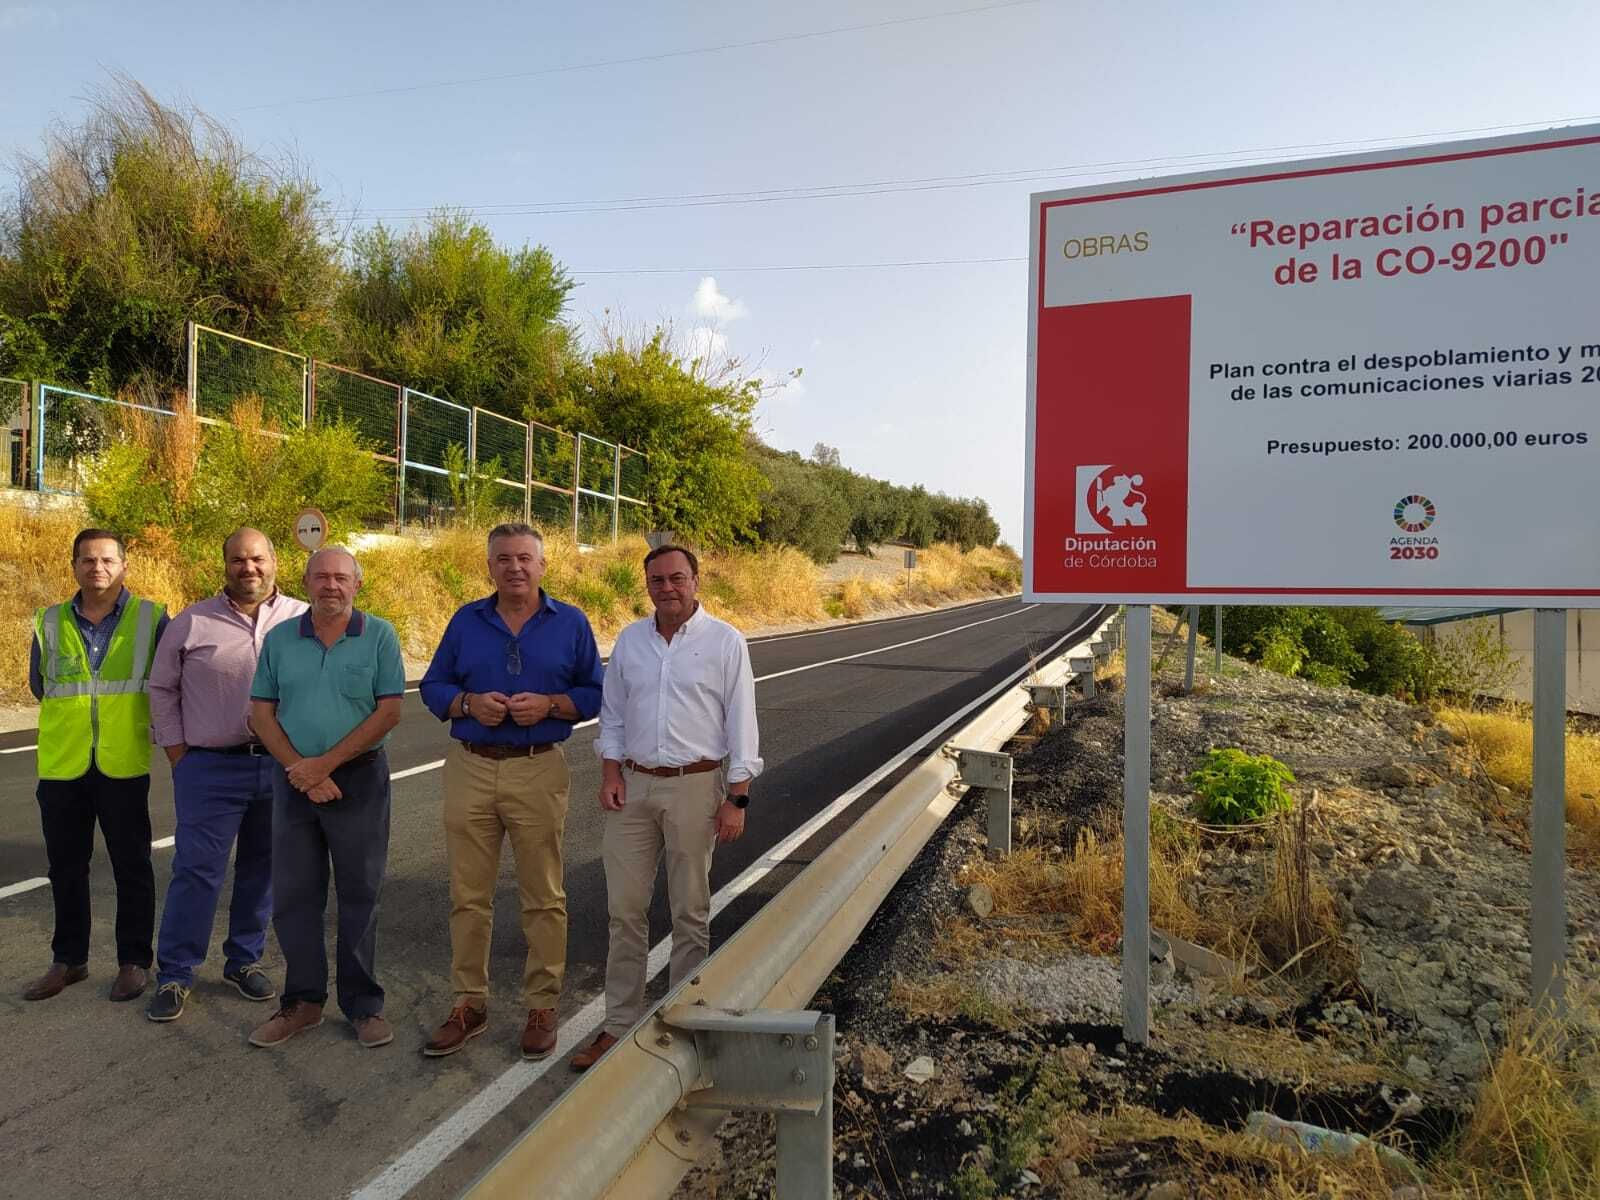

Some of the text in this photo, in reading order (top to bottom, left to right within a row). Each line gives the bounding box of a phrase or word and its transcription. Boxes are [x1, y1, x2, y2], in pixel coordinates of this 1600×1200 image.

[1063, 231, 1149, 259] OBRAS
[1274, 257, 1318, 286] de
[1332, 253, 1362, 281] la
[1209, 362, 1255, 380] Plan
[1261, 359, 1331, 377] contra
[1337, 354, 1356, 372] el
[1363, 344, 1550, 373] despoblamiento
[1557, 345, 1572, 365] y
[1230, 384, 1256, 402] de
[1263, 383, 1293, 400] las
[1300, 374, 1485, 398] comunicaciones
[1492, 367, 1573, 389] viarias
[1267, 430, 1589, 457] Presupuesto: 200.000,00 euros
[1065, 537, 1157, 554] Diputación
[1390, 536, 1439, 546] AGENDA
[1390, 546, 1439, 560] 2030
[1064, 554, 1157, 568] de Córdoba
